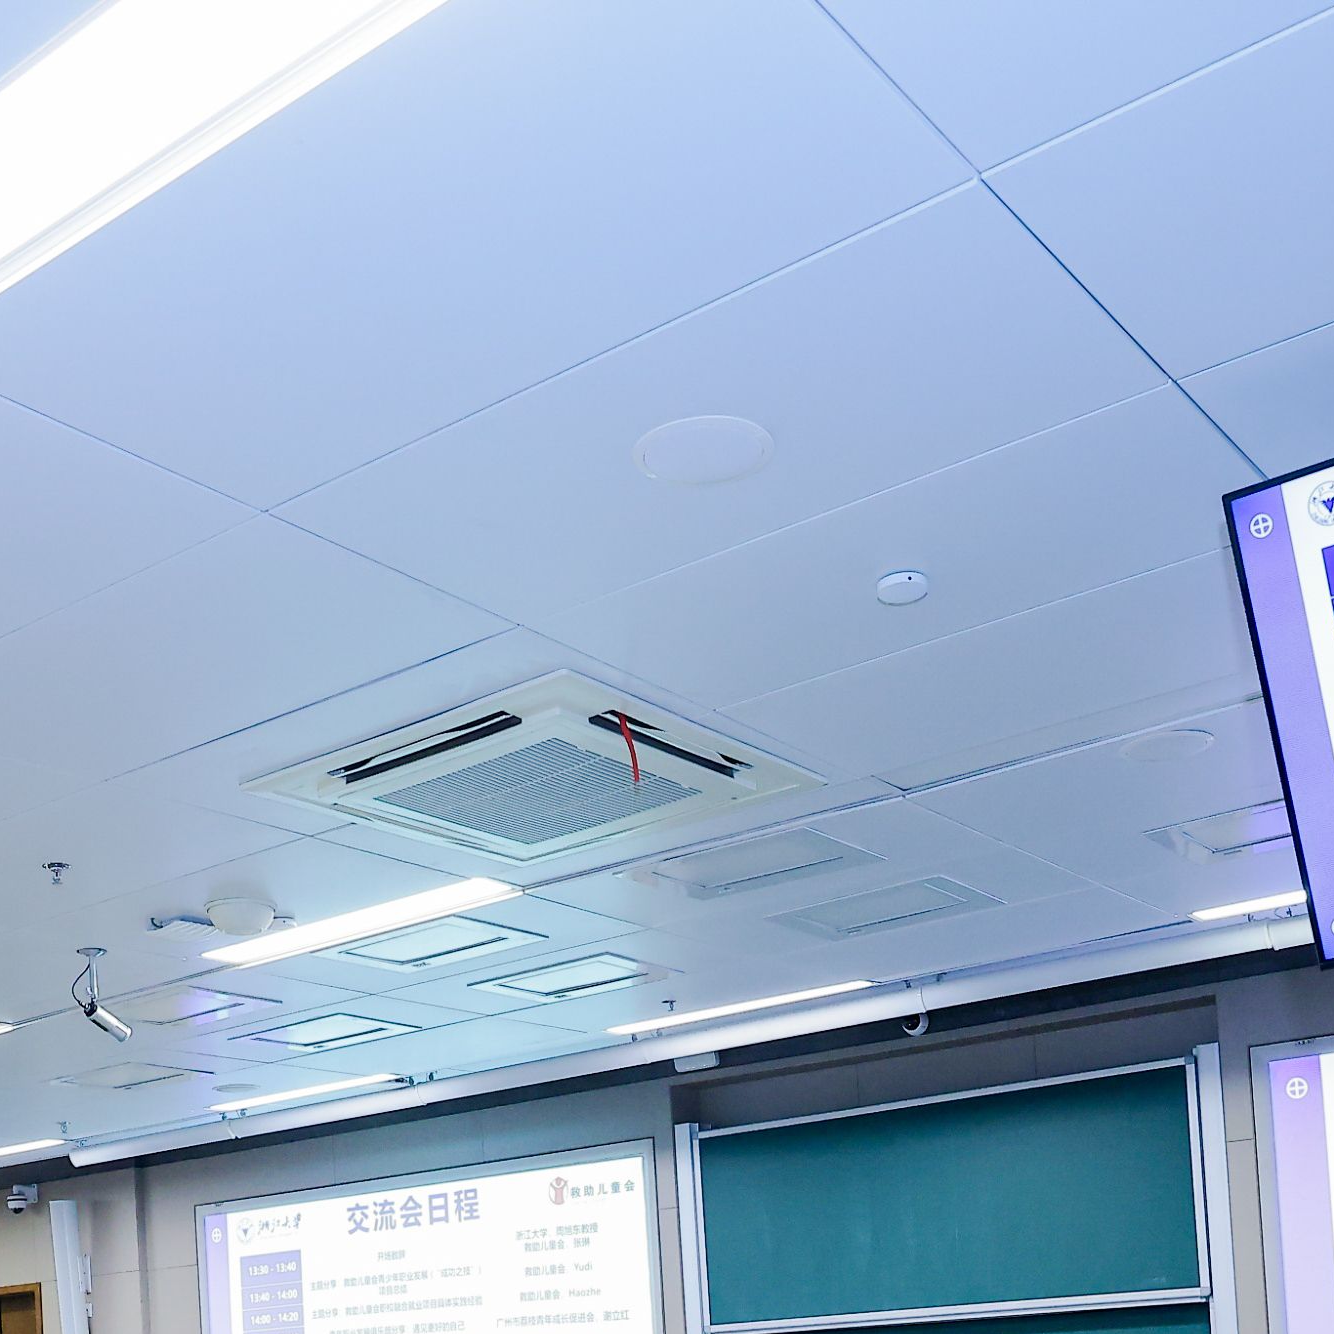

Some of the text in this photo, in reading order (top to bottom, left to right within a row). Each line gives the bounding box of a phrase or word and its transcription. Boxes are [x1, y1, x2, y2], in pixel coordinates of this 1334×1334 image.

[346, 1187, 481, 1235] 交流会日程
